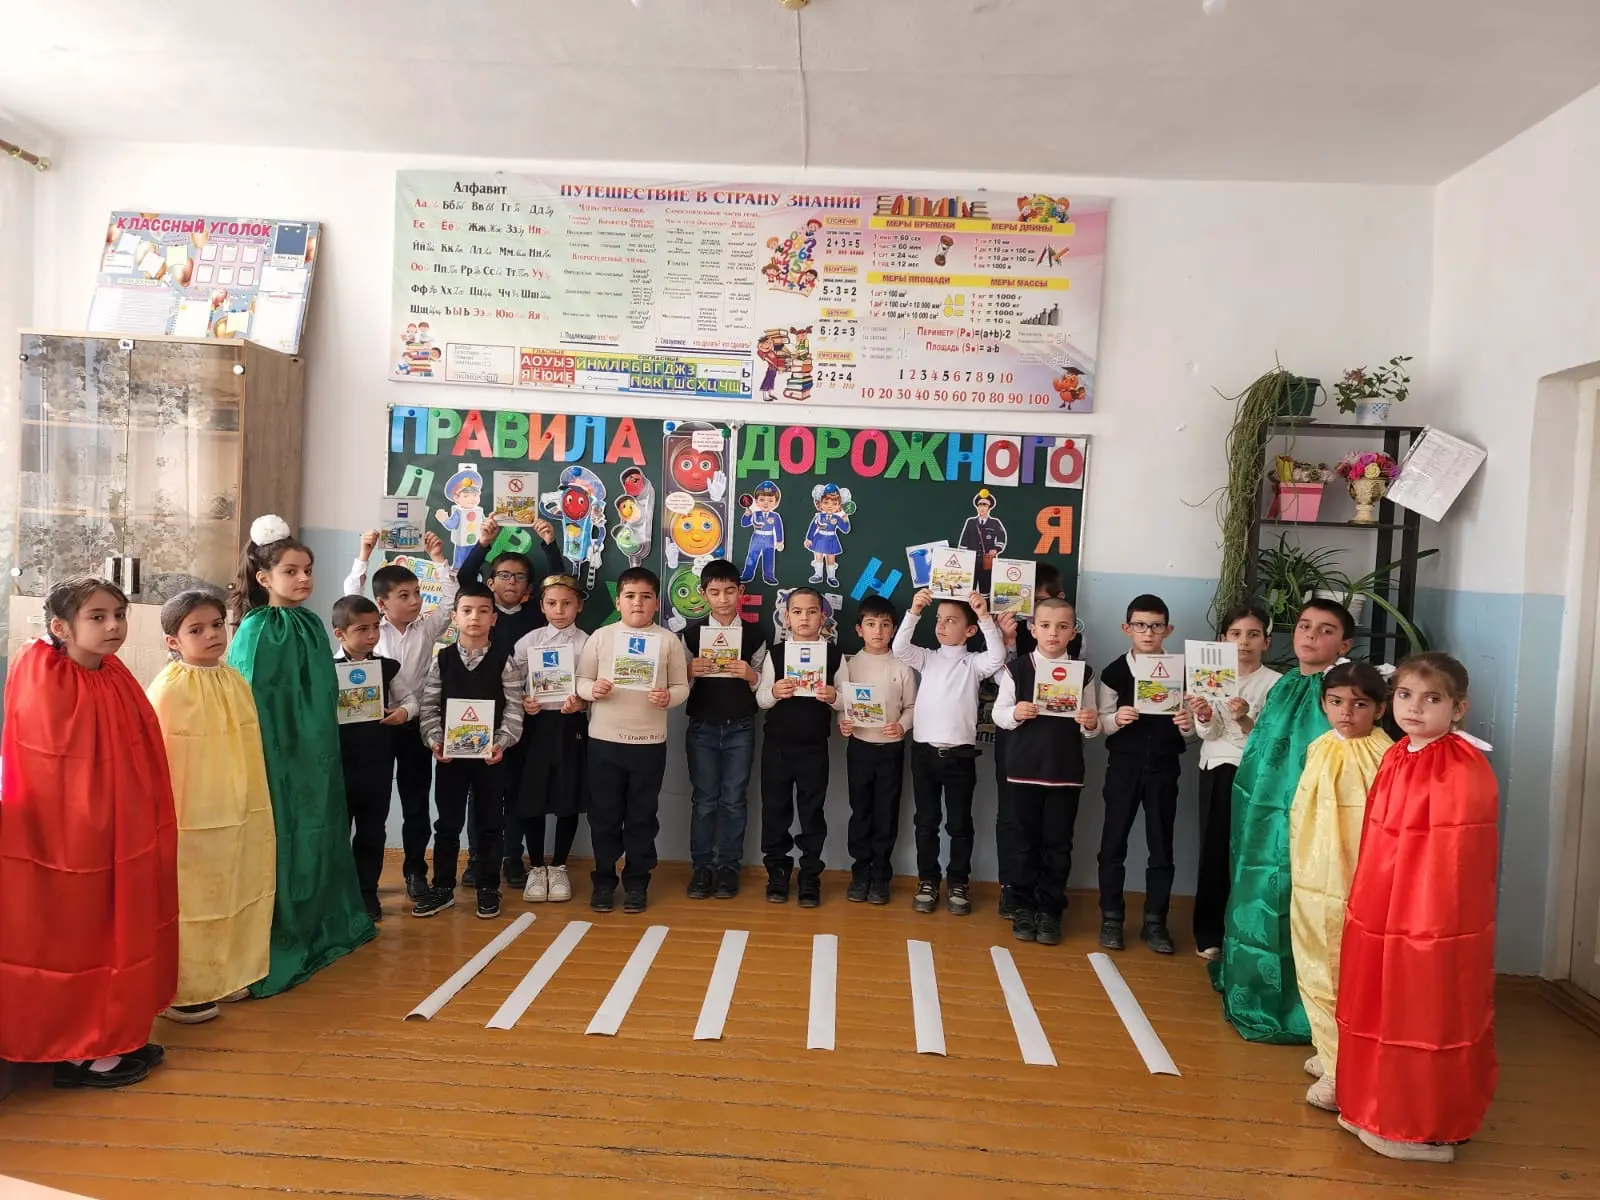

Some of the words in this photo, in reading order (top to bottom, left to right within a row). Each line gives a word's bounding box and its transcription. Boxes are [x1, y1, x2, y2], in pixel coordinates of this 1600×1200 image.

[454, 182, 507, 196] Алфавит
[560, 184, 690, 202] ПУТЕШЕСТВИЕ
[696, 191, 708, 203] В
[714, 191, 780, 206] СТРАНУ
[786, 192, 861, 208] ЗНАНИЙ
[117, 217, 206, 234] КЛАССНЫЙ
[210, 222, 272, 238] УГОЛОК
[886, 220, 912, 228] МЕРЫ
[914, 220, 956, 229] ВРЕМЕНИ
[992, 223, 1017, 231] МЕРЫ
[1019, 224, 1053, 232] ДЛИНЫ
[908, 276, 950, 284] ПЛОЩАДИ
[1017, 280, 1048, 288] МАССЫ
[900, 369, 904, 380] 1
[909, 370, 916, 380] 2
[920, 370, 927, 381] 3
[931, 370, 938, 380] 4
[942, 370, 950, 381] 5
[953, 371, 960, 382] 6
[965, 372, 972, 382] 7
[976, 372, 984, 382] 8
[987, 372, 994, 383] 9
[1000, 372, 1014, 384] 10
[861, 387, 874, 398] 10
[880, 388, 893, 400] 20
[896, 389, 911, 400] 30
[915, 389, 930, 400] 40
[934, 390, 948, 402] 50
[952, 390, 967, 402] 60
[972, 392, 986, 402] 70
[989, 392, 1004, 404] 80
[1008, 392, 1023, 404] 90
[1029, 394, 1050, 404] 100
[392, 406, 647, 466] ПРАВИЛА
[737, 424, 1084, 484] ДОРОЖНОГО
